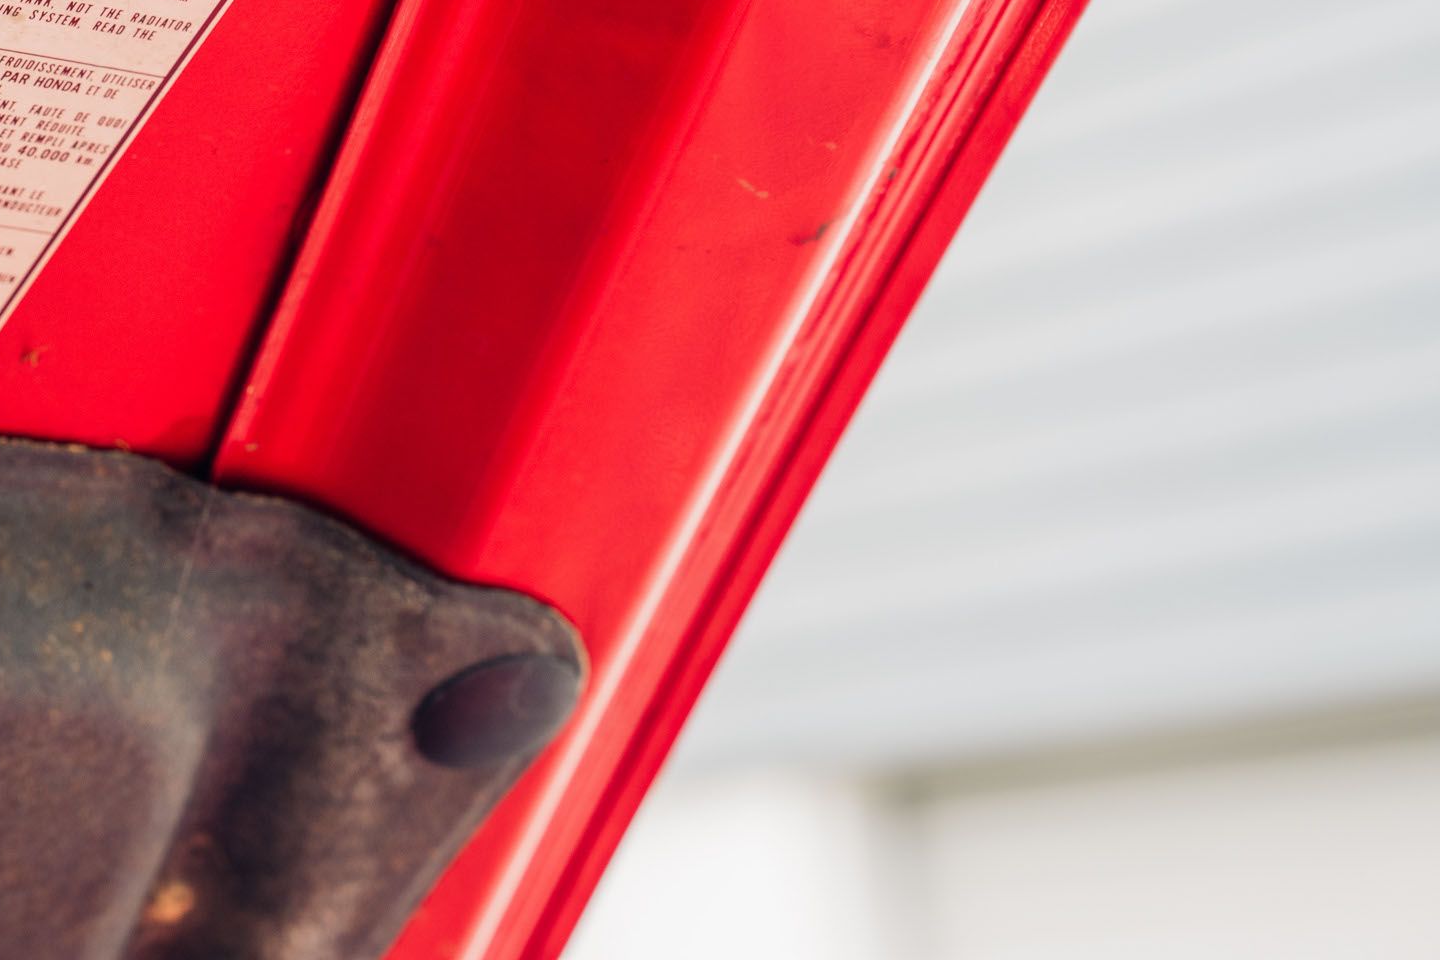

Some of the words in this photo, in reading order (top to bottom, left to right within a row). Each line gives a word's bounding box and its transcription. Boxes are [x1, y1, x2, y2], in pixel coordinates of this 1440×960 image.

[65, 0, 94, 14] NOT
[98, 5, 124, 20] THE
[91, 19, 126, 35] READ
[131, 26, 156, 41] THE
[0, 69, 31, 85] PAR
[32, 75, 81, 93] HONDA
[100, 72, 155, 90] UTILISER
